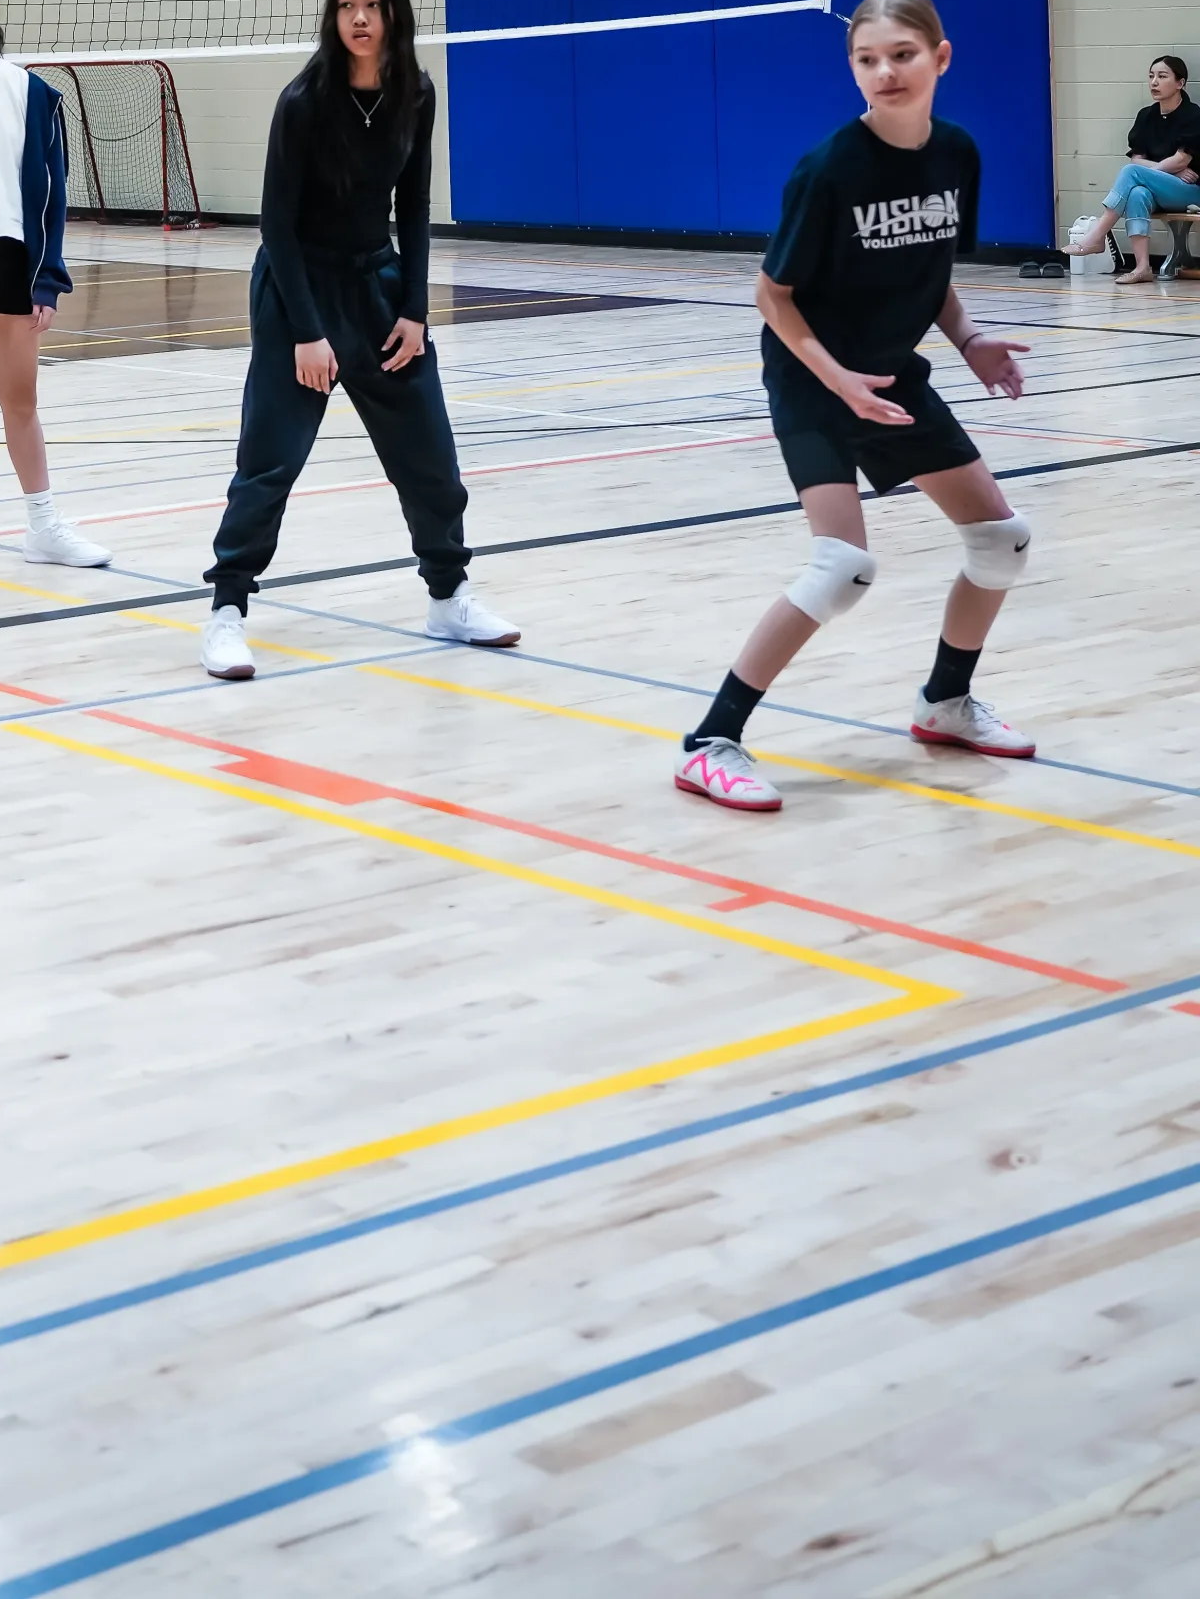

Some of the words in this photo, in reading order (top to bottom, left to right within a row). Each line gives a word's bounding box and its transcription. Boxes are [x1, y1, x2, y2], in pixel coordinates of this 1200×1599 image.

[852, 188, 960, 237] VISION
[862, 231, 934, 249] VOLLEYBALL
[936, 226, 957, 239] CLUB
